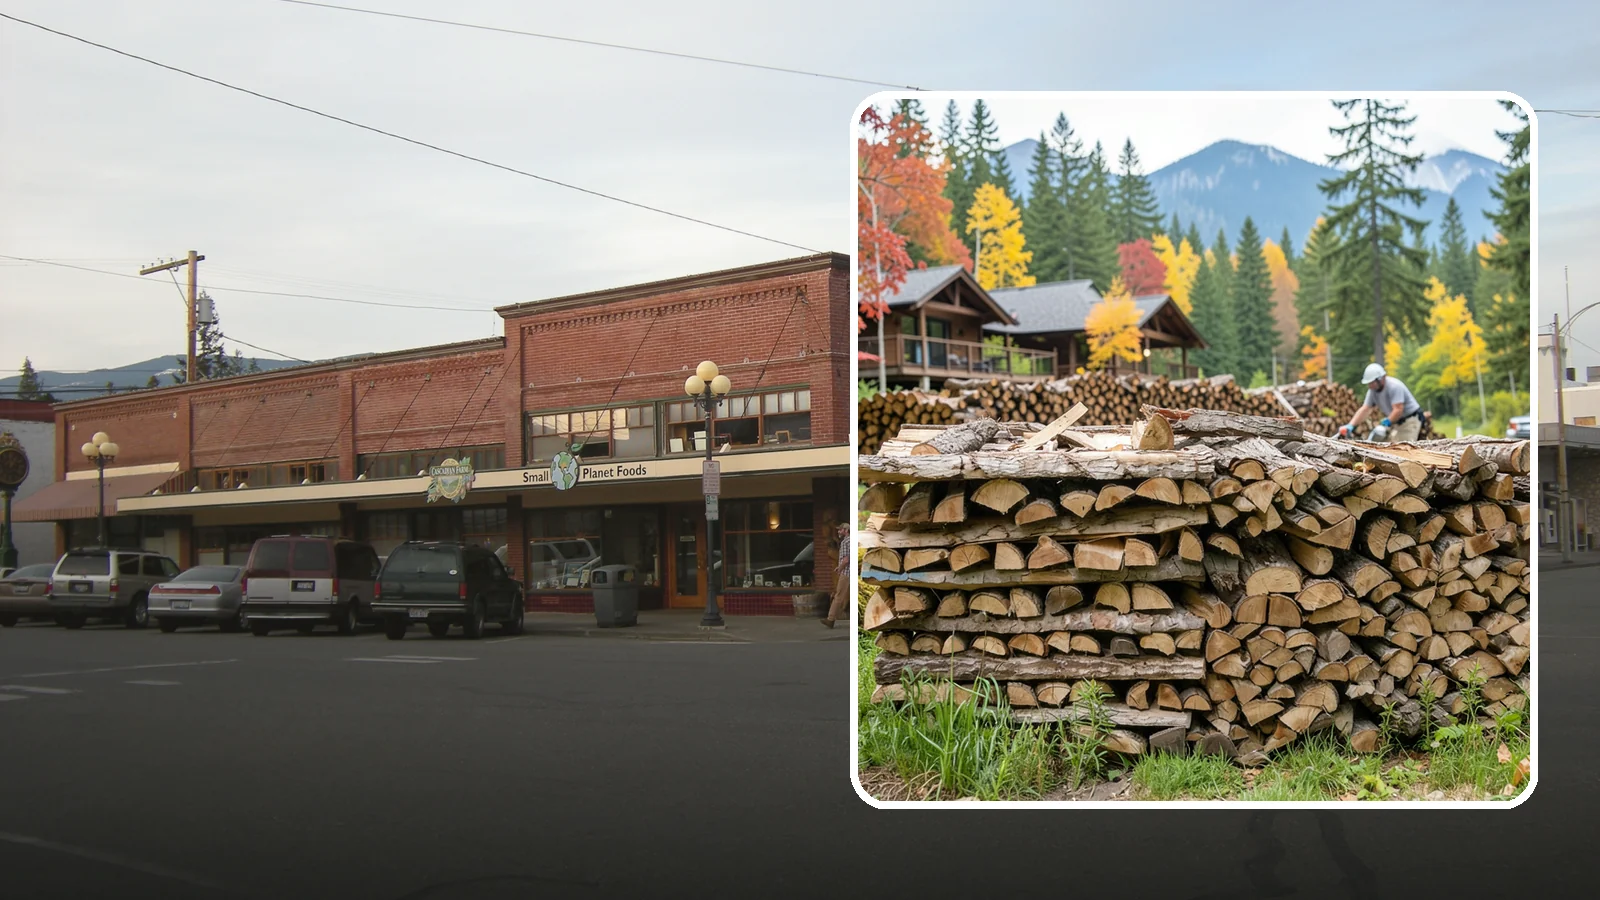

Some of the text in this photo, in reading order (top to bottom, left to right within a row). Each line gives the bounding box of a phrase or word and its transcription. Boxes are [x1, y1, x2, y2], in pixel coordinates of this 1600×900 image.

[523, 464, 647, 483] Small Planet Foods
